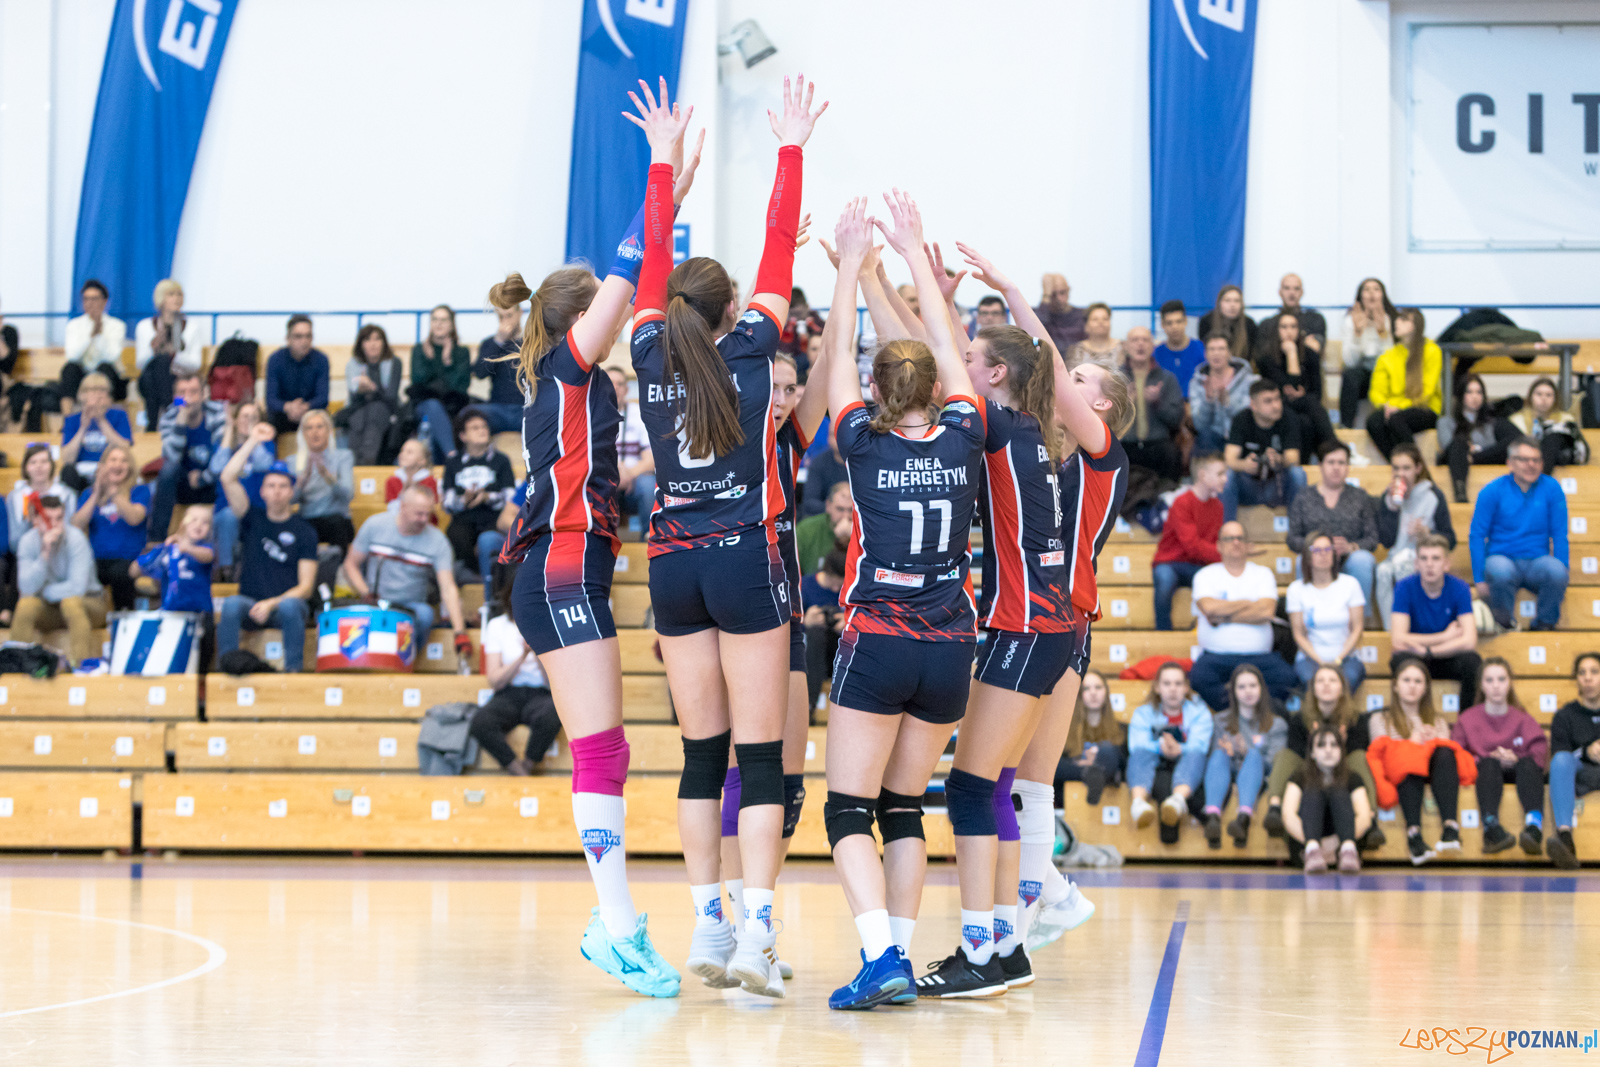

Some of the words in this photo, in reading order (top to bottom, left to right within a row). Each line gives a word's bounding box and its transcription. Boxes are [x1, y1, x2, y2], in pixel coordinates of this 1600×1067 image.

[649, 184, 662, 244] pro-function
[905, 457, 943, 471] ENEA
[877, 465, 968, 489] ENERGETYK
[778, 582, 787, 603] 8
[558, 603, 587, 629] 14
